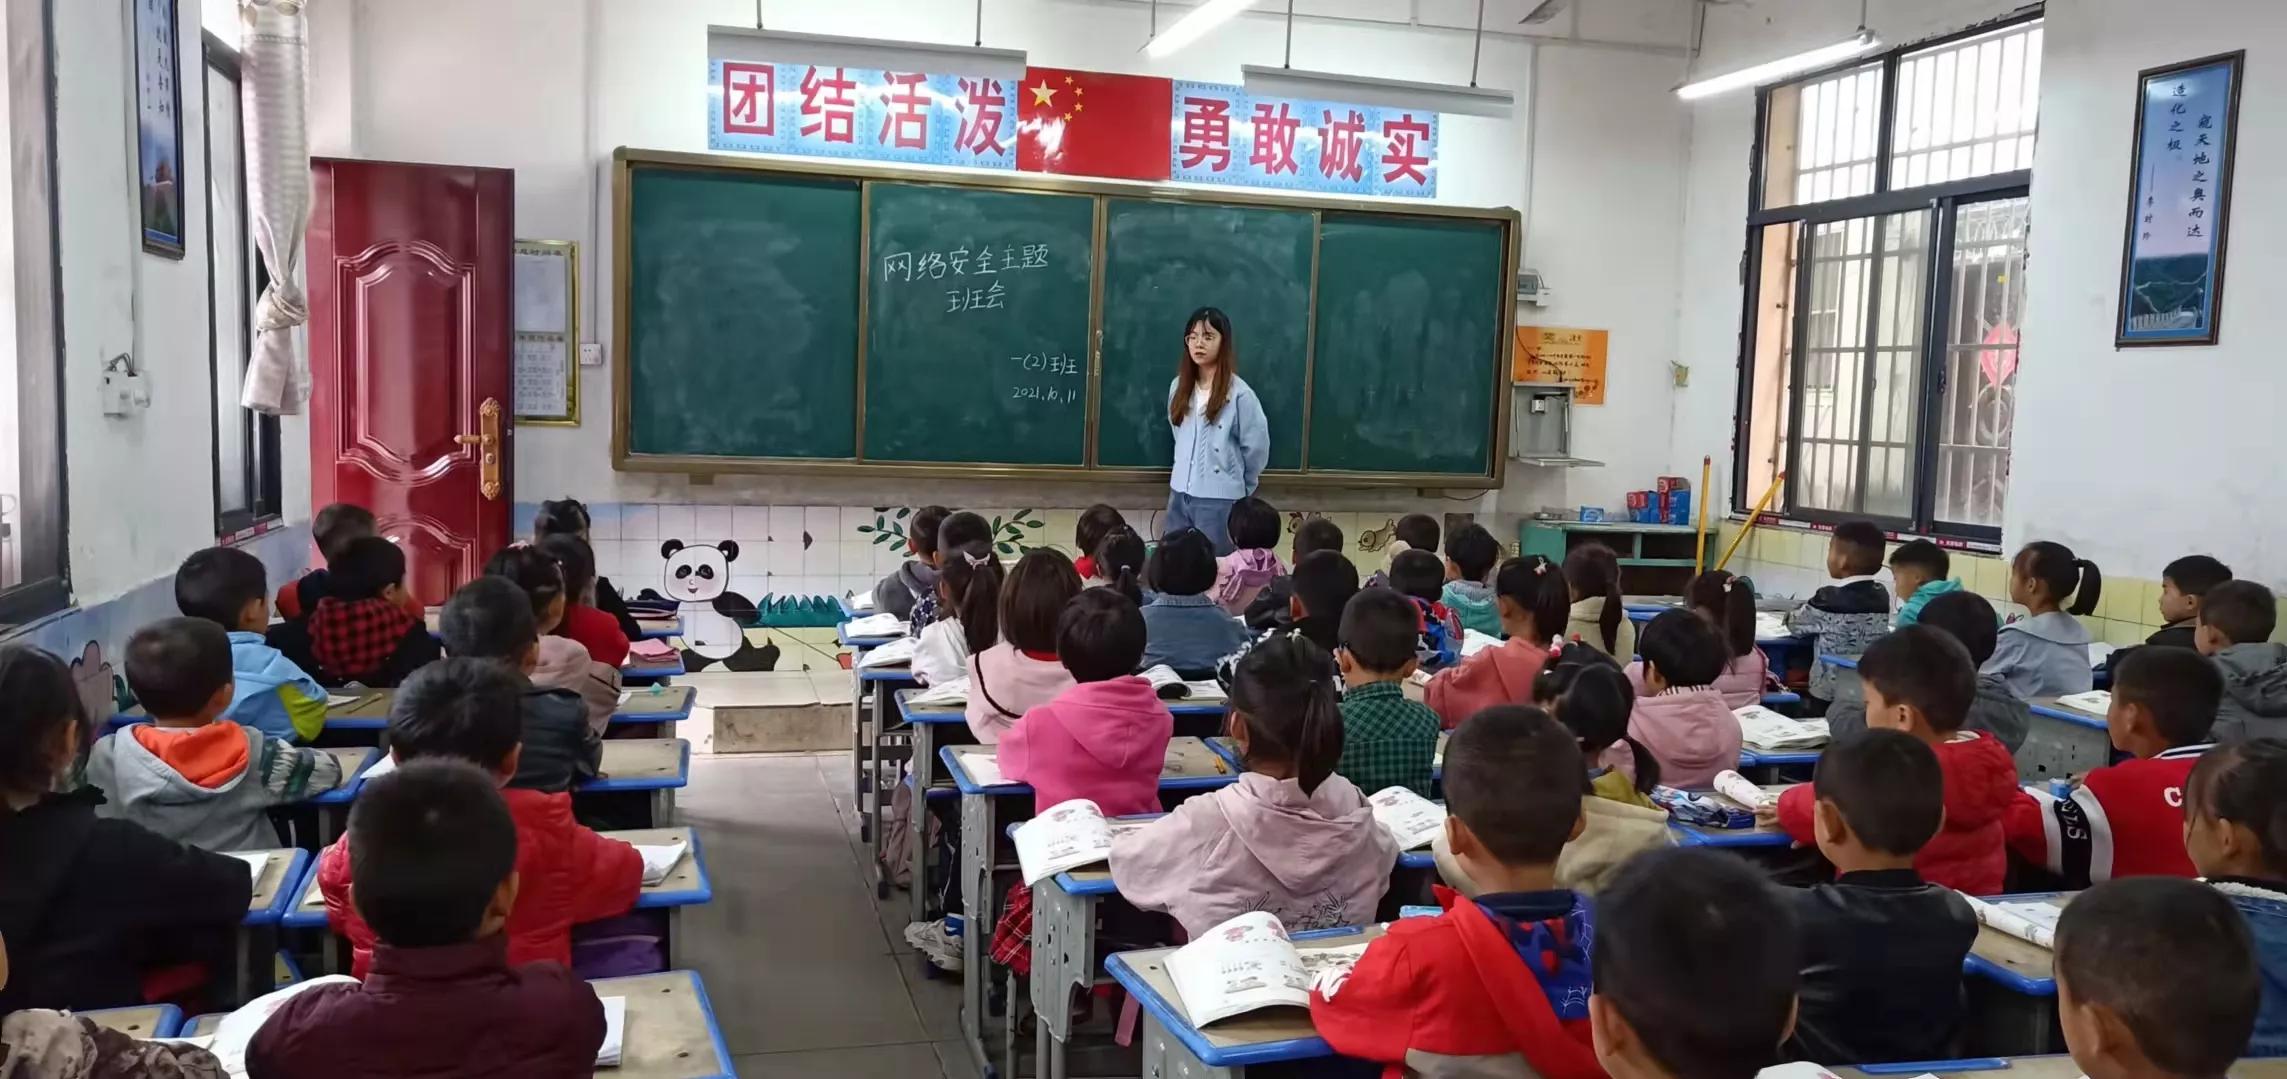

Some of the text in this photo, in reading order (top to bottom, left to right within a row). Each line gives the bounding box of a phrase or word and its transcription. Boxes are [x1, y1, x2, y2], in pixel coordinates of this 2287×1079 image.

[722, 61, 1006, 156] 团结活泼
[1179, 96, 1430, 184] 勇敢诚实
[2167, 83, 2187, 151] 造化之极
[884, 243, 1049, 282] 网络安全主题
[945, 279, 1006, 313] 班会
